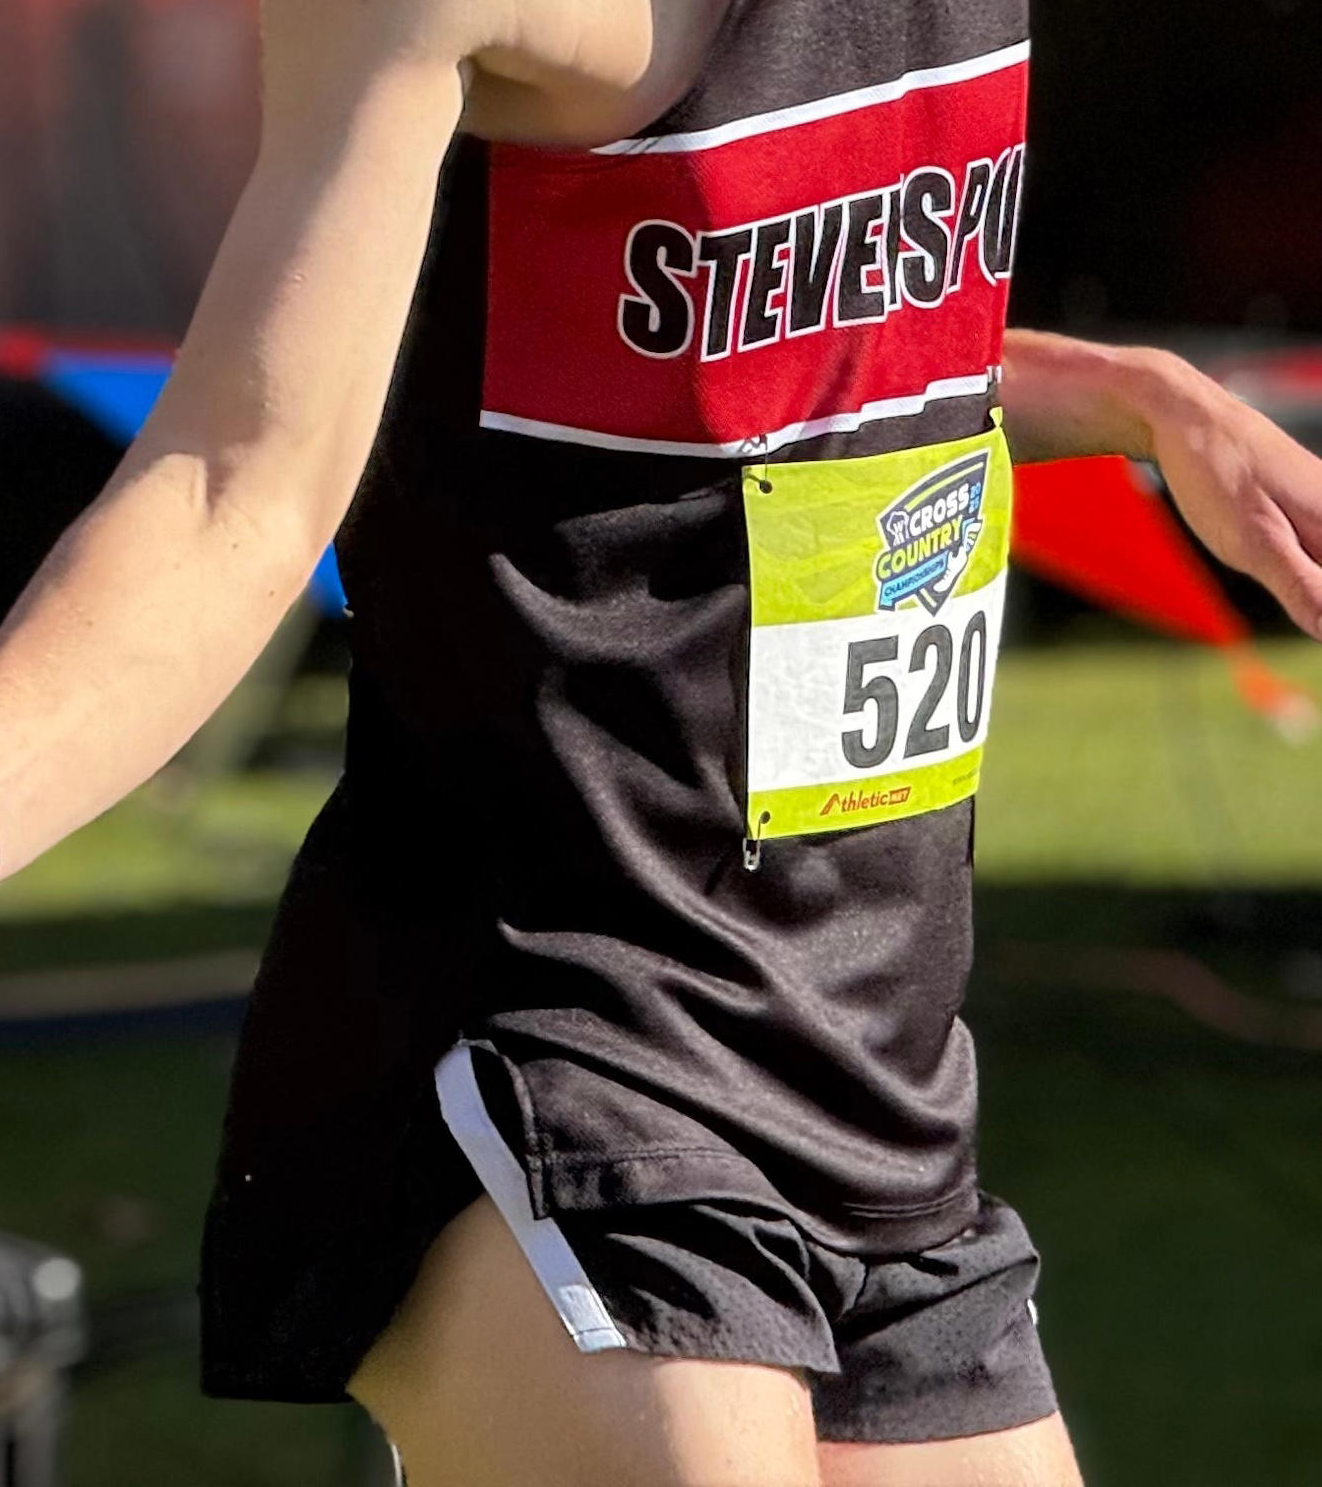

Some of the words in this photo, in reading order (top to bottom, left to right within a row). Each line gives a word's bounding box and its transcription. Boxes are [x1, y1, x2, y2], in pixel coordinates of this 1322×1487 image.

[909, 483, 969, 536] CROSS
[878, 515, 963, 579] COUNTRY
[884, 558, 945, 597] CHAMPIONSHIPS
[841, 610, 987, 768] 520
